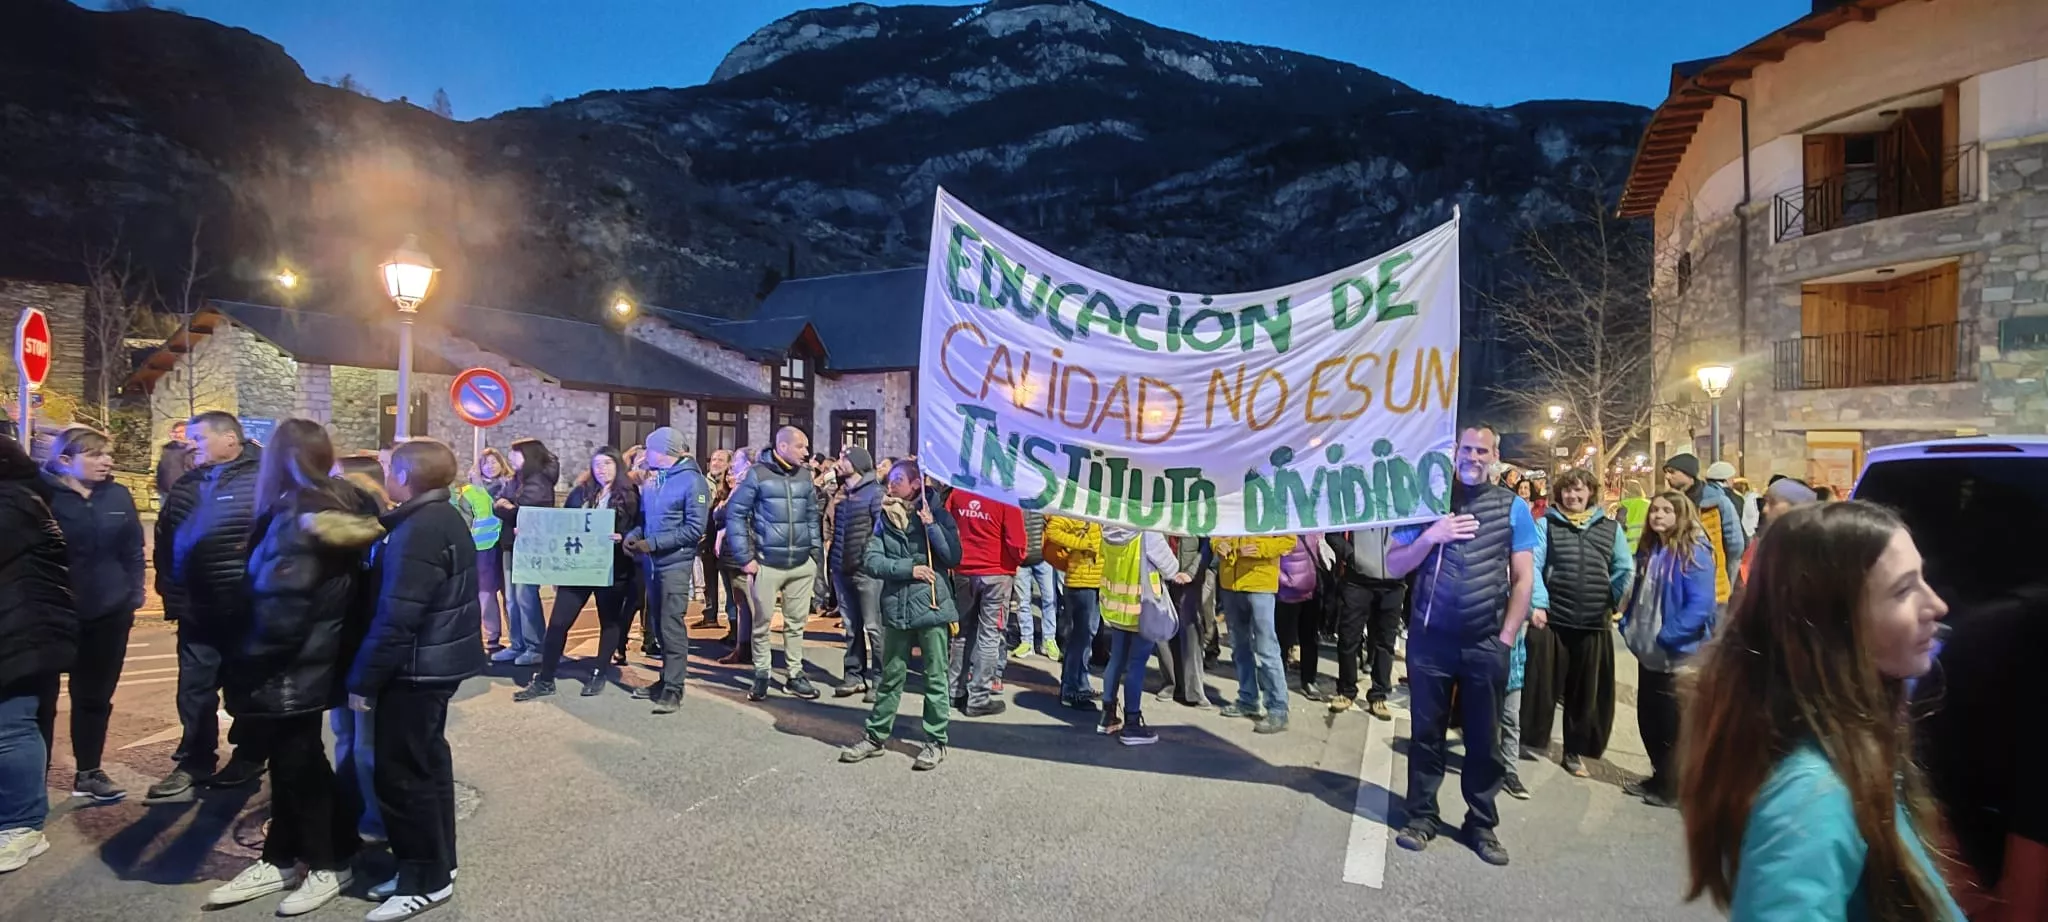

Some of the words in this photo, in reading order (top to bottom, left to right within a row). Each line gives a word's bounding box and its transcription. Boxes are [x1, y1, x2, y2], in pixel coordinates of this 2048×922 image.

[1332, 250, 1418, 331] DE
[26, 338, 47, 357] STOP
[1205, 363, 1289, 432] NO
